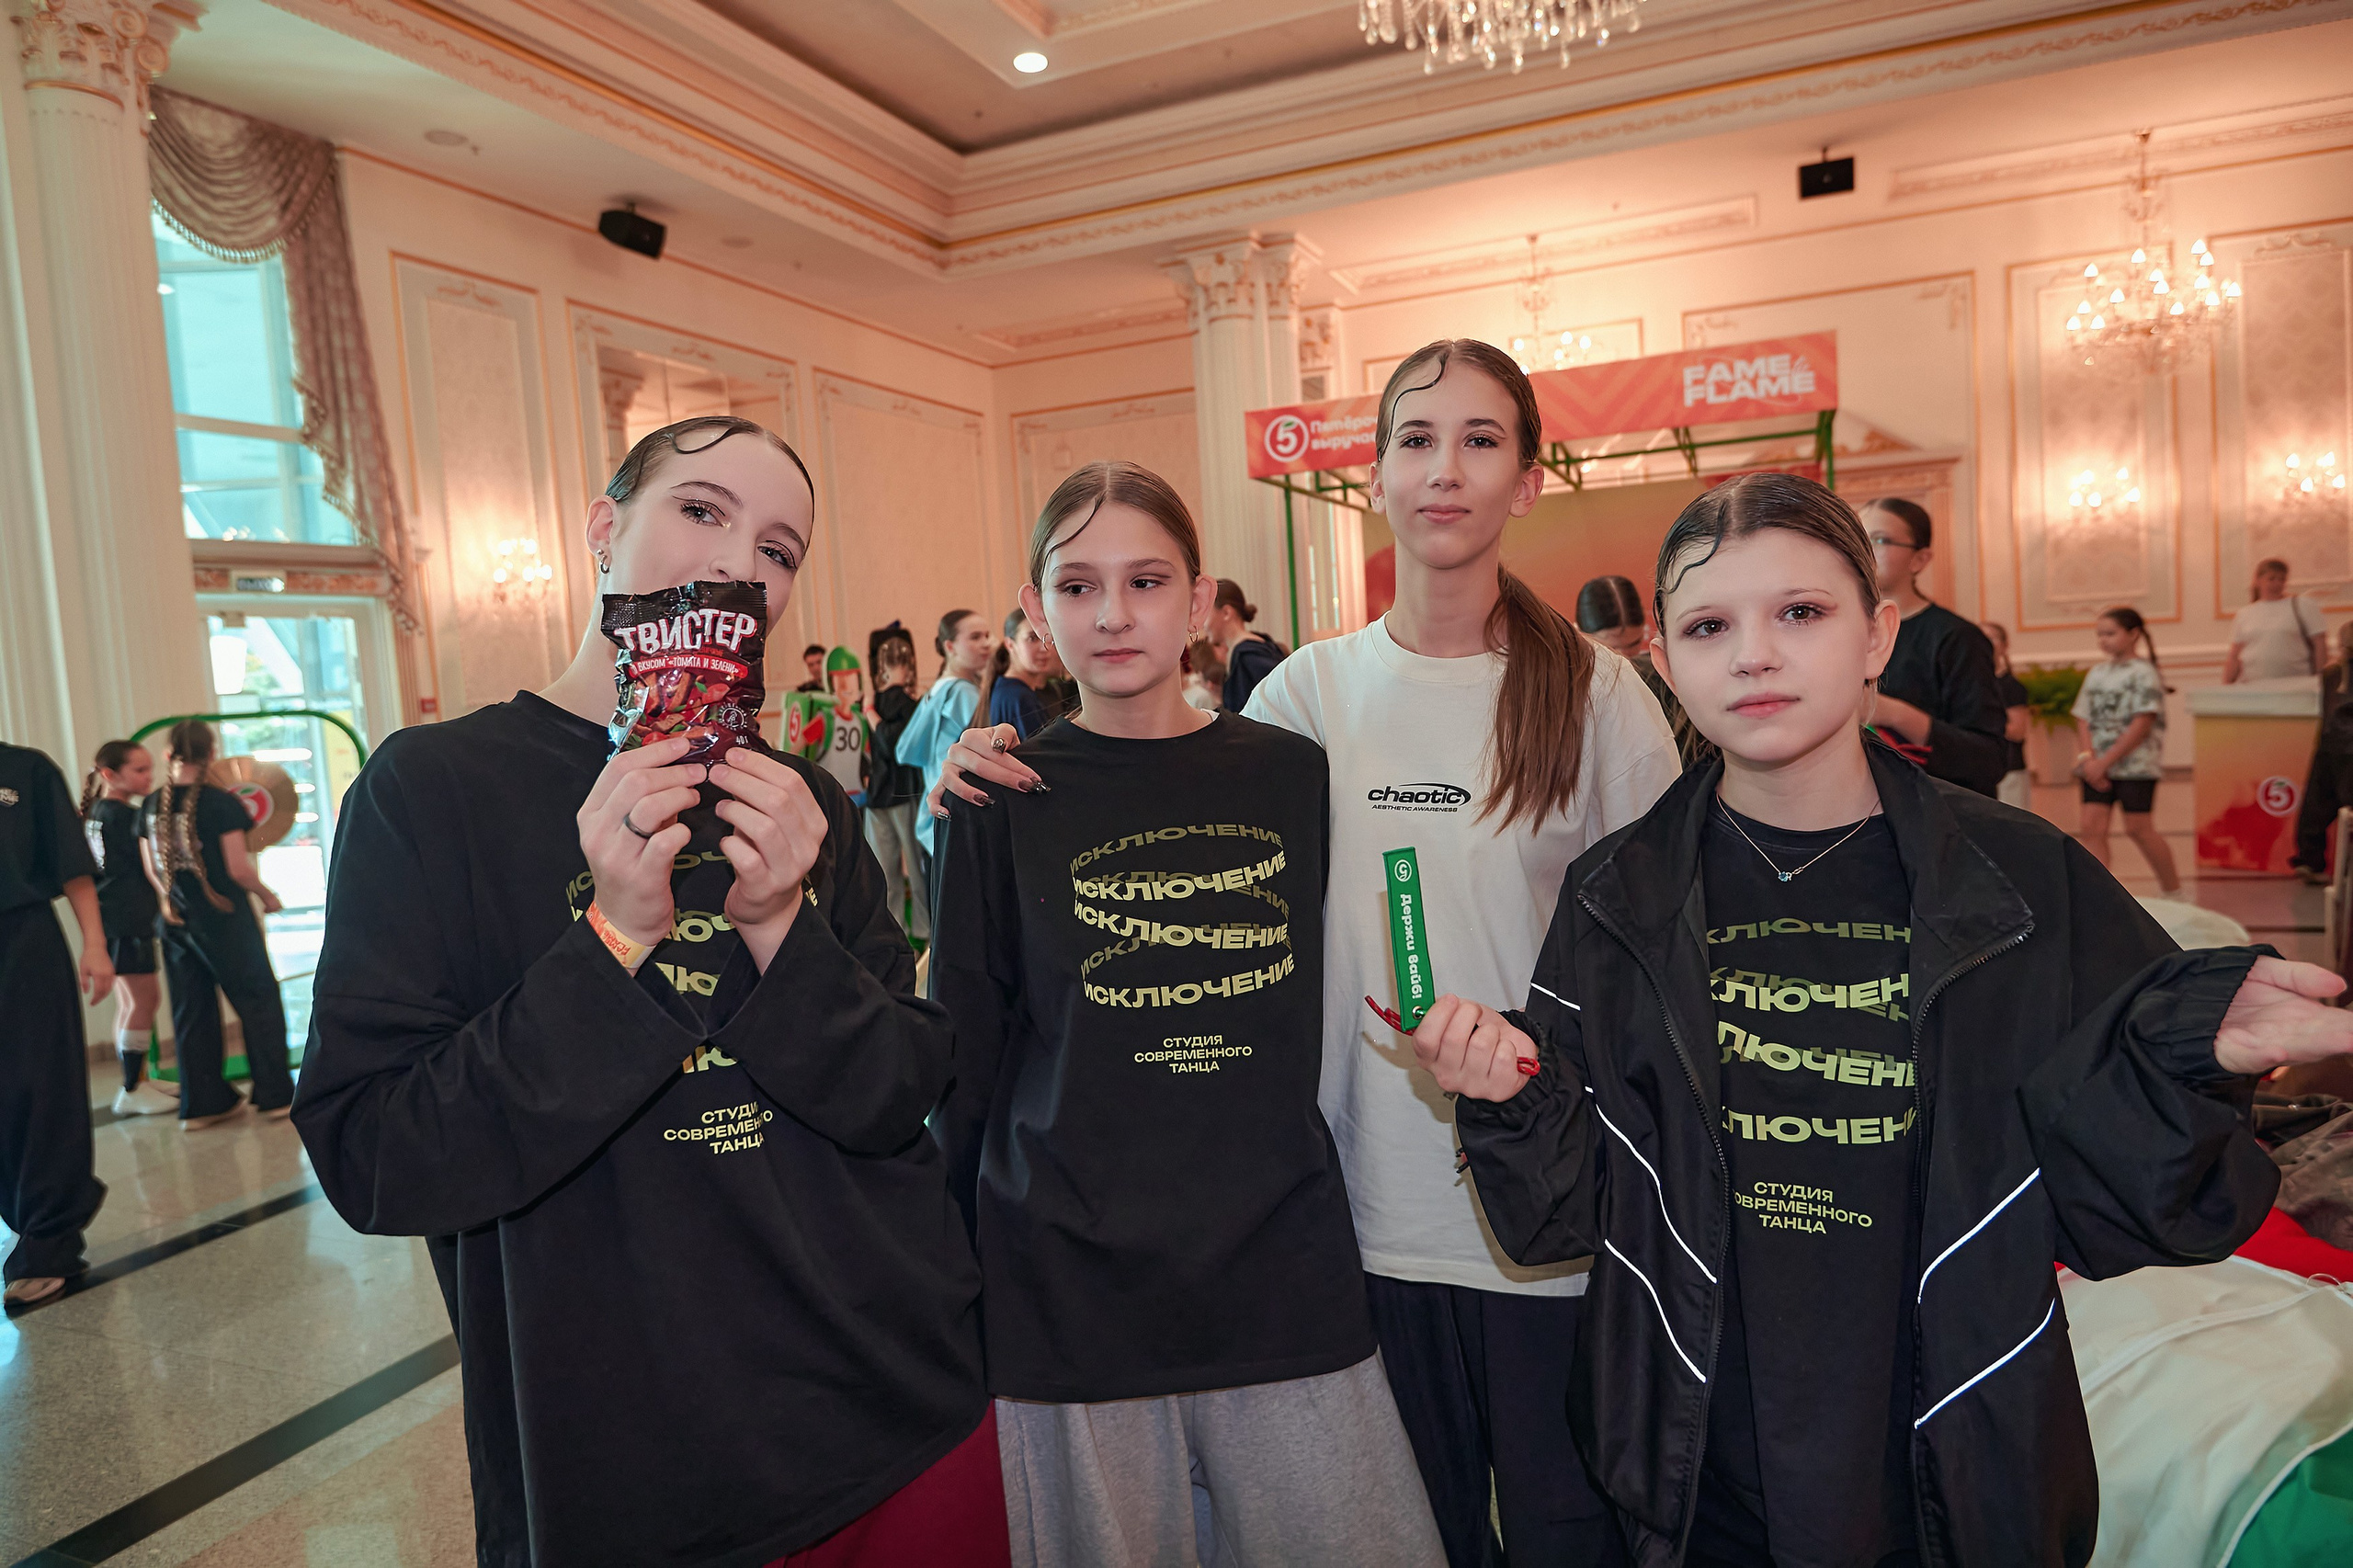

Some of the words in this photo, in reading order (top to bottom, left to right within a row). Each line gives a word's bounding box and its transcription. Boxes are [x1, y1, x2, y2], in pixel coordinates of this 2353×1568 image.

[1684, 354, 1790, 386] FAME
[1684, 371, 1815, 407] FLAME
[614, 608, 757, 653] ТВИСТЕР
[638, 660, 665, 672] ВКУСОМ
[703, 659, 709, 667] И
[835, 726, 861, 751] 30
[1368, 784, 1469, 805] chaotic
[1069, 824, 1284, 876] ИСКЛЮЧЕНИЕ
[1073, 850, 1287, 901] ИСКЛЮЧЕНИЕ
[1074, 899, 1289, 949] ИСКЛЮЧЕНИЕ
[1400, 893, 1415, 951] Держи
[1084, 953, 1295, 1008] ИСКЛЮЧЕНИЕ
[1133, 1045, 1253, 1063] СОВРЕМЕННОГО
[1163, 1035, 1223, 1049] СТУДИЯ
[1169, 1061, 1221, 1074] ТАНЦА
[1753, 1181, 1834, 1203] СТУДИЯ
[1733, 1190, 1873, 1228] ОВРЕМЕННОГО
[1758, 1213, 1826, 1234] ТАНЦА
